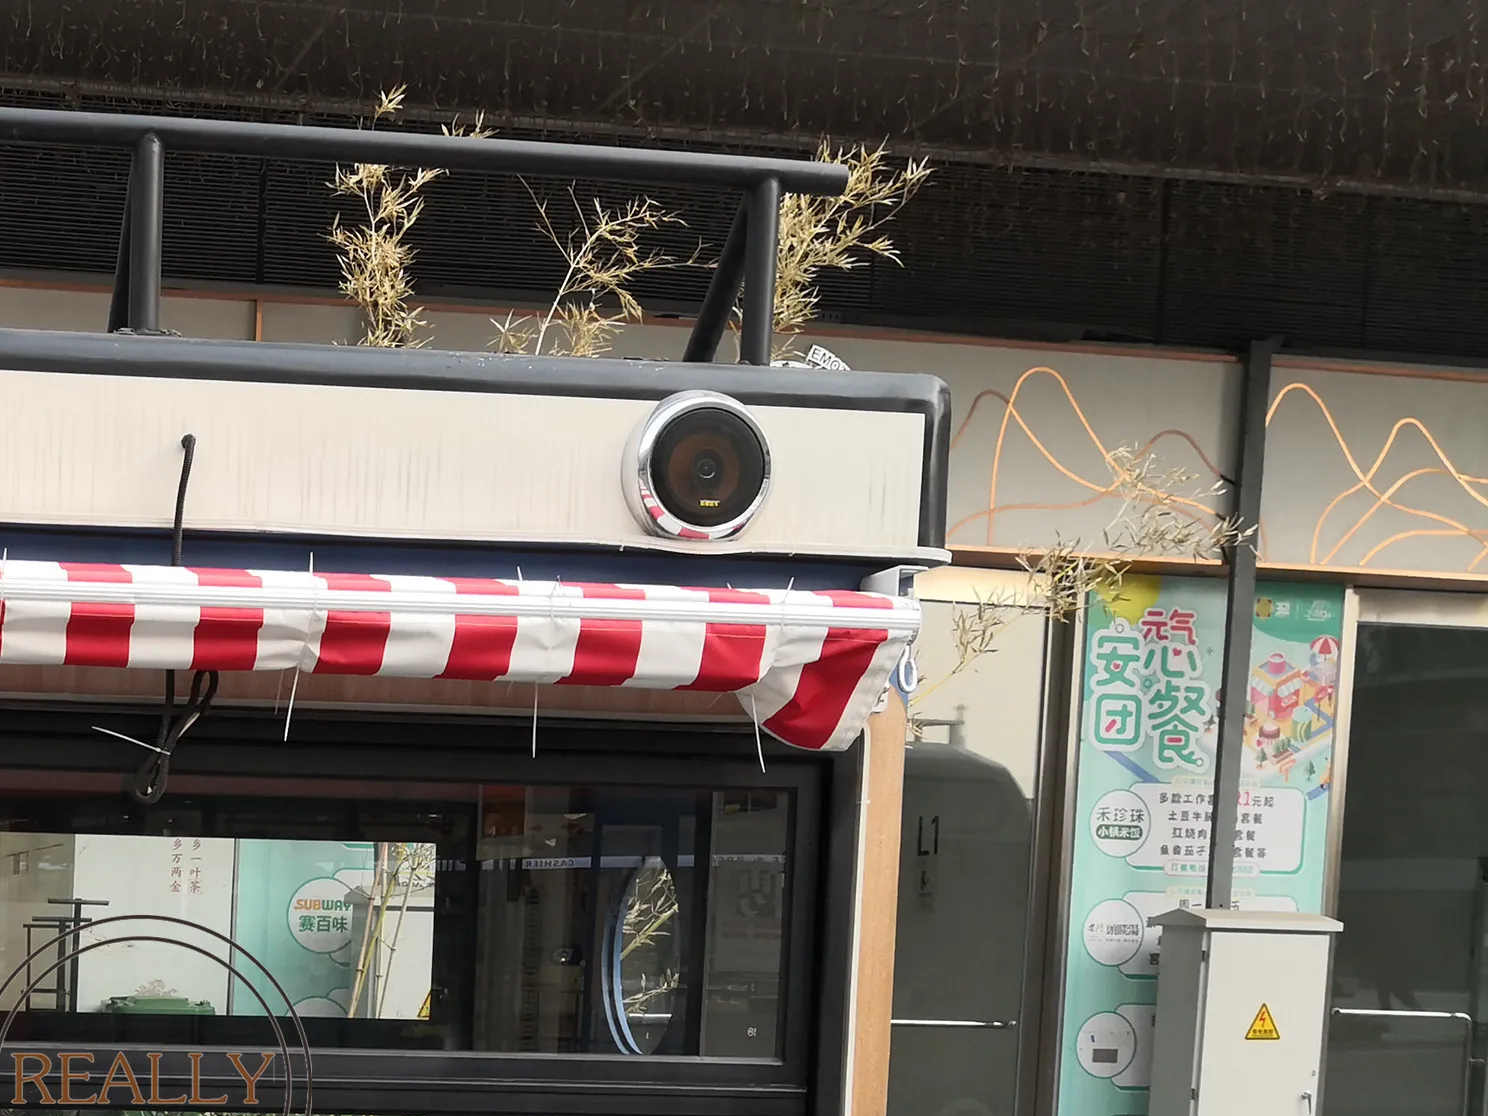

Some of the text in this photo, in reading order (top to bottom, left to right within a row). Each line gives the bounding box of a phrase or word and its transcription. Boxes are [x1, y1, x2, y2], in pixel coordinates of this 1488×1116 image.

[1097, 806, 1145, 823] 禾珍珠
[917, 816, 940, 857] L1
[294, 898, 352, 911] SUBWAY
[299, 915, 348, 934] 赛百味
